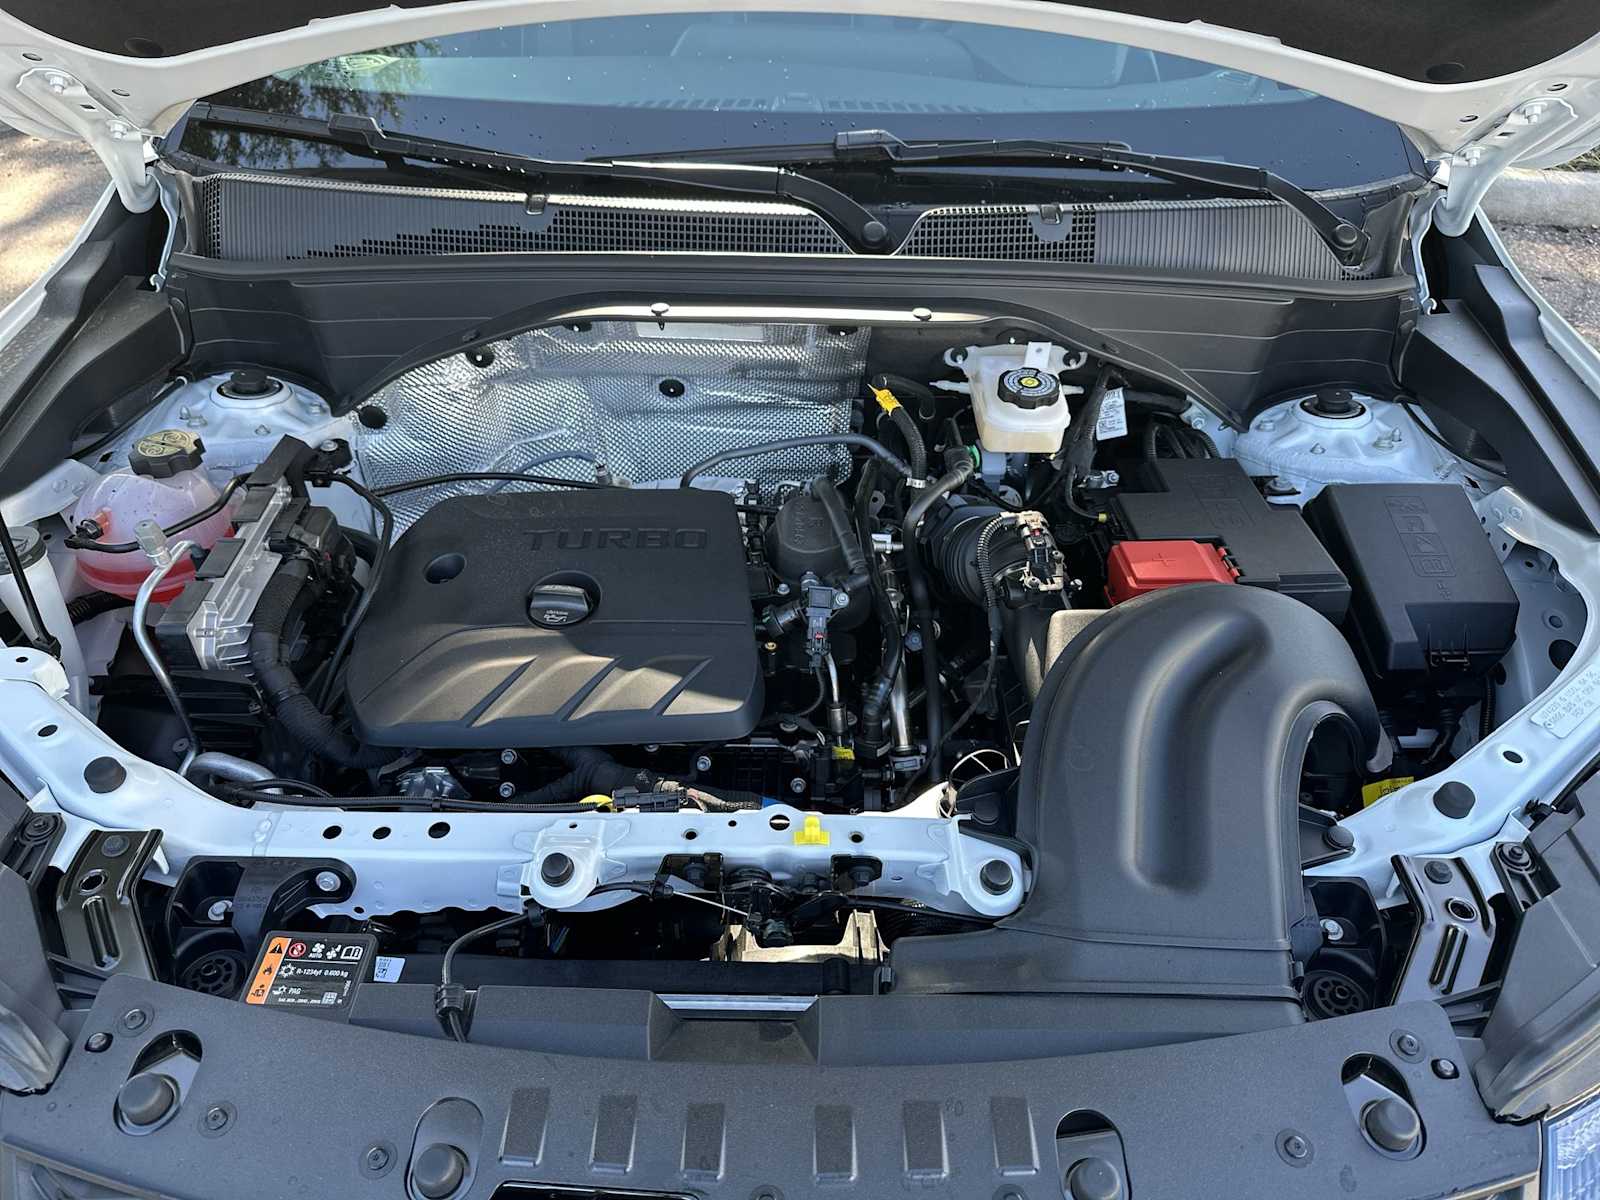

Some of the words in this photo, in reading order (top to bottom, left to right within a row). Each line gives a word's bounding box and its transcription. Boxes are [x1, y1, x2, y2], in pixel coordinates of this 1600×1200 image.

[523, 528, 707, 550] TURBO
[296, 968, 322, 976] R-1234yf
[340, 970, 349, 978] kg
[288, 987, 302, 995] PAG
